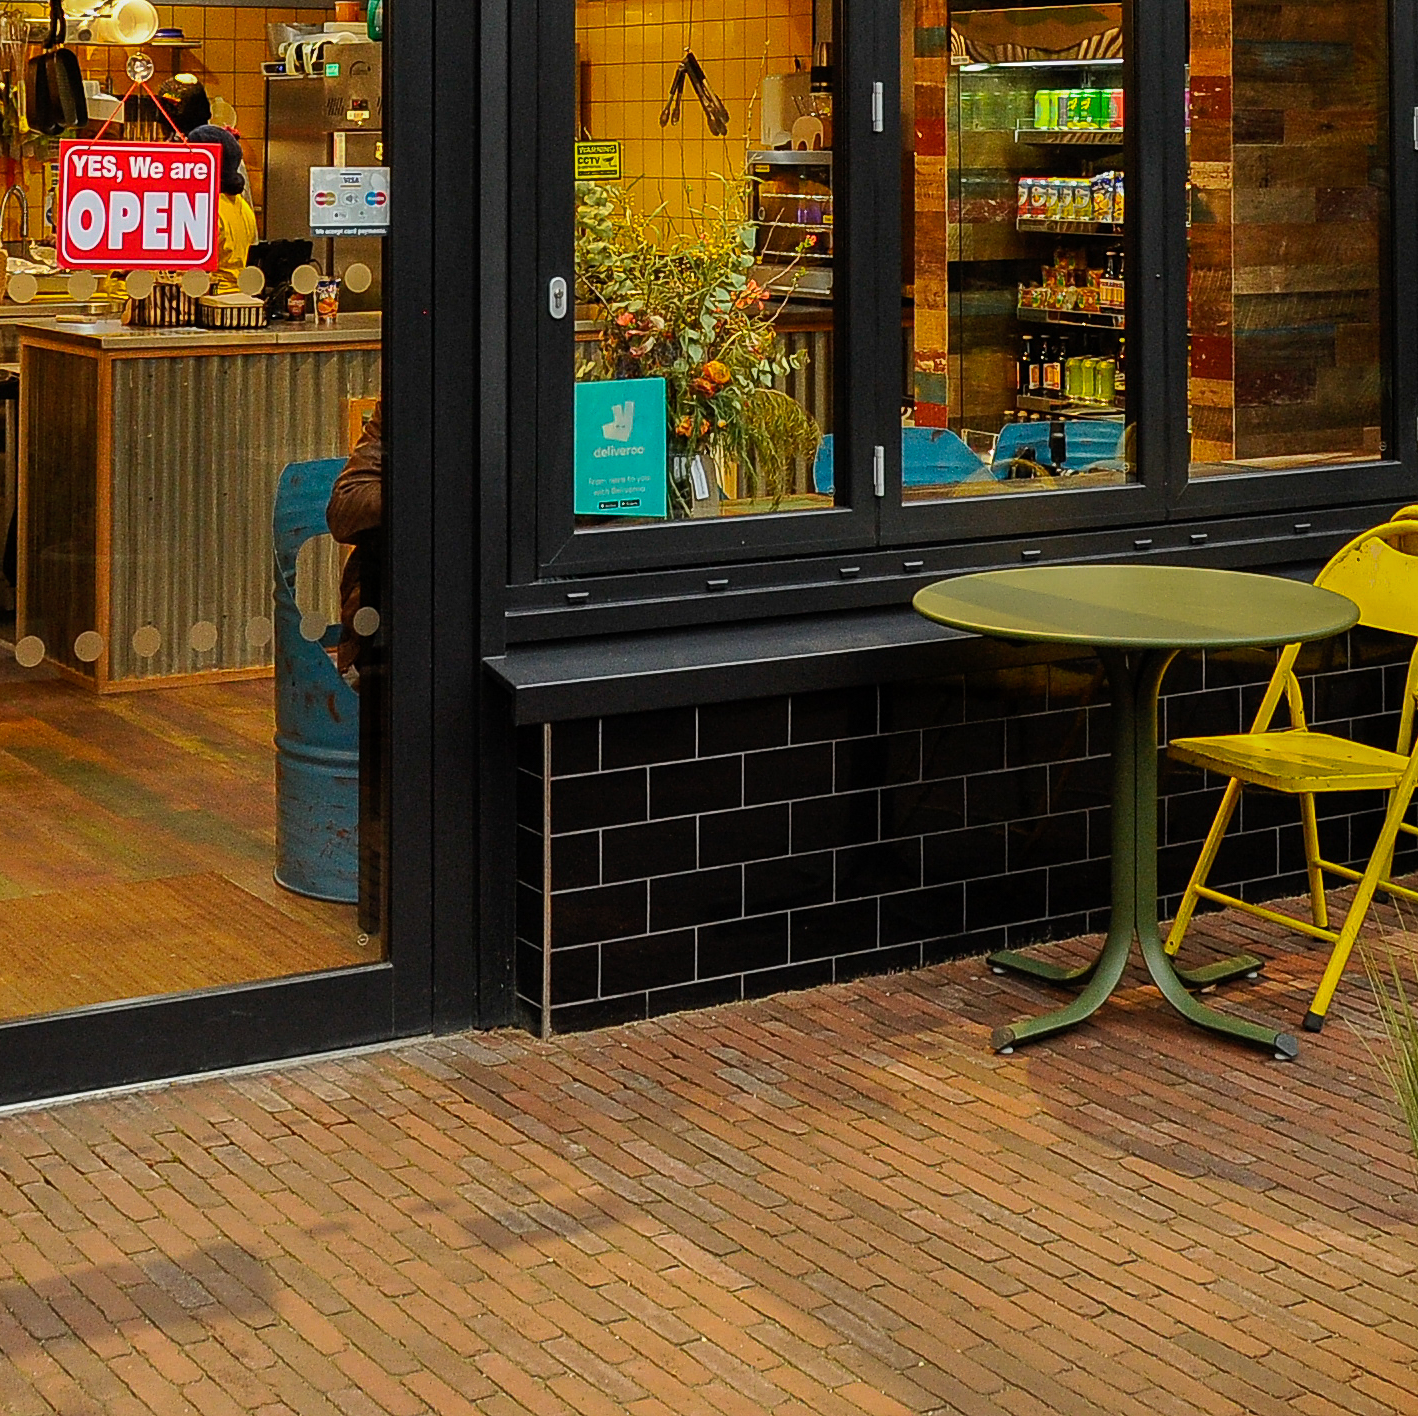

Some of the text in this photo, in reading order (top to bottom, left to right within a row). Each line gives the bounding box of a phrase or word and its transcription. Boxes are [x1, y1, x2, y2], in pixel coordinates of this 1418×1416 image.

[577, 155, 600, 165] CCTV
[71, 154, 209, 183] YES, We are
[342, 176, 360, 184] VISA
[67, 189, 209, 251] OPEN
[593, 445, 644, 458] deliveroo
